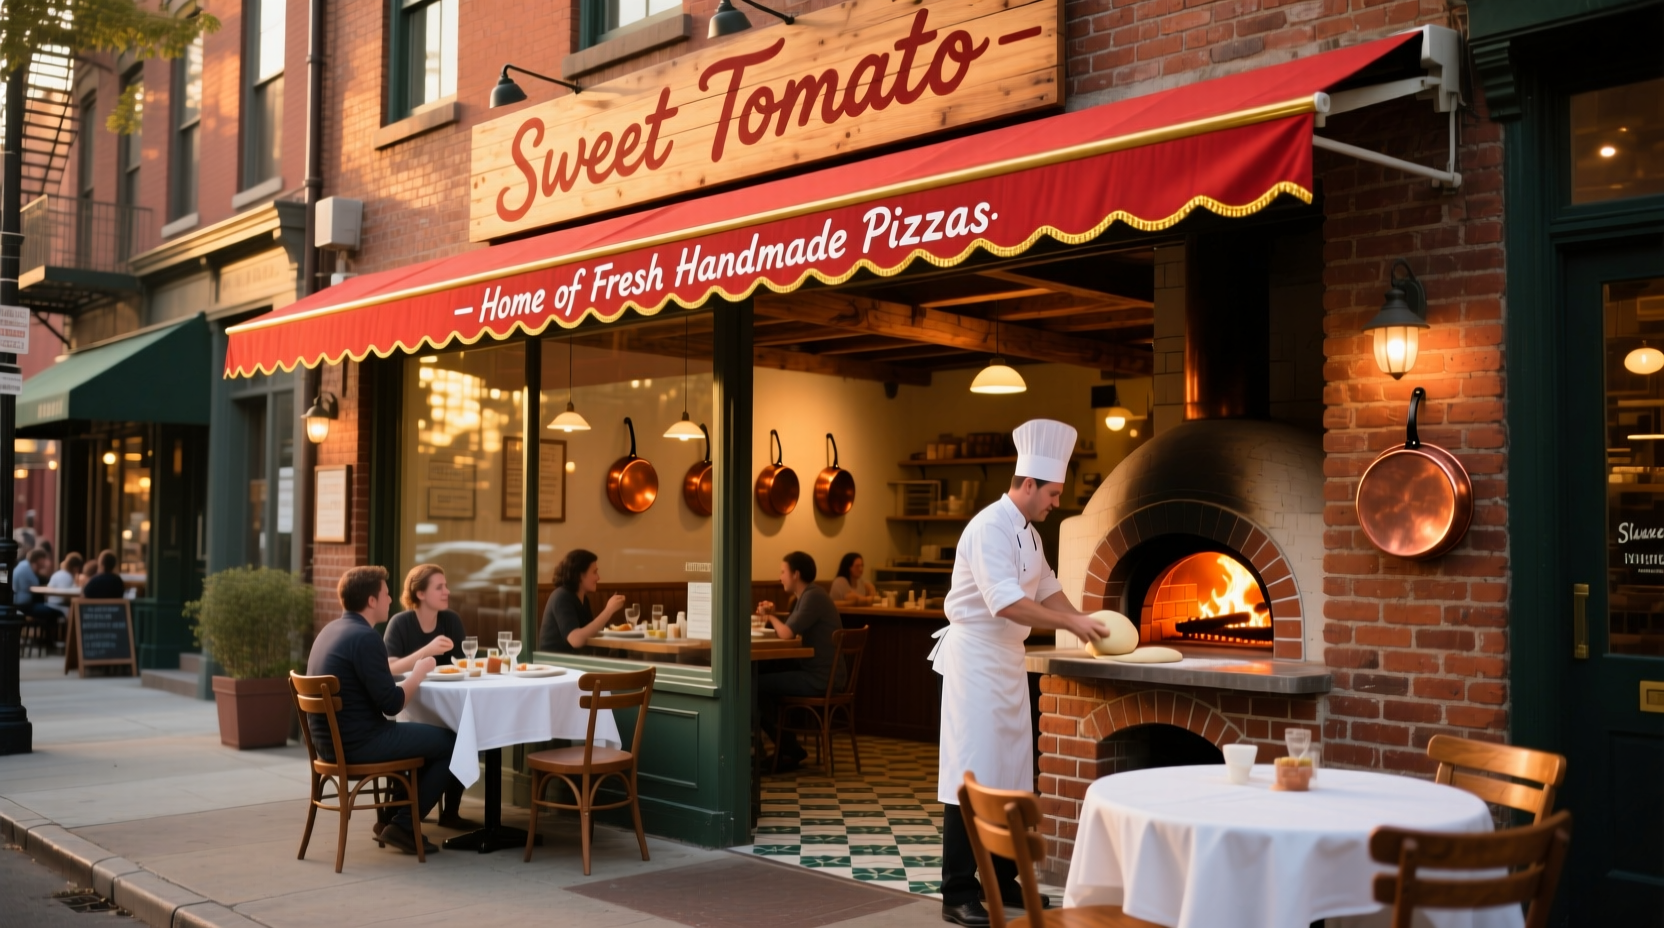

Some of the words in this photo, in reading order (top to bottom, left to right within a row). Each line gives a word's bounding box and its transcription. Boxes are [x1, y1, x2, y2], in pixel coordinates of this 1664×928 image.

[496, 86, 679, 222] Sweet
[479, 285, 546, 323] Home
[554, 268, 587, 317] of
[590, 252, 664, 303] Fresh
[674, 218, 848, 288] Handmade
